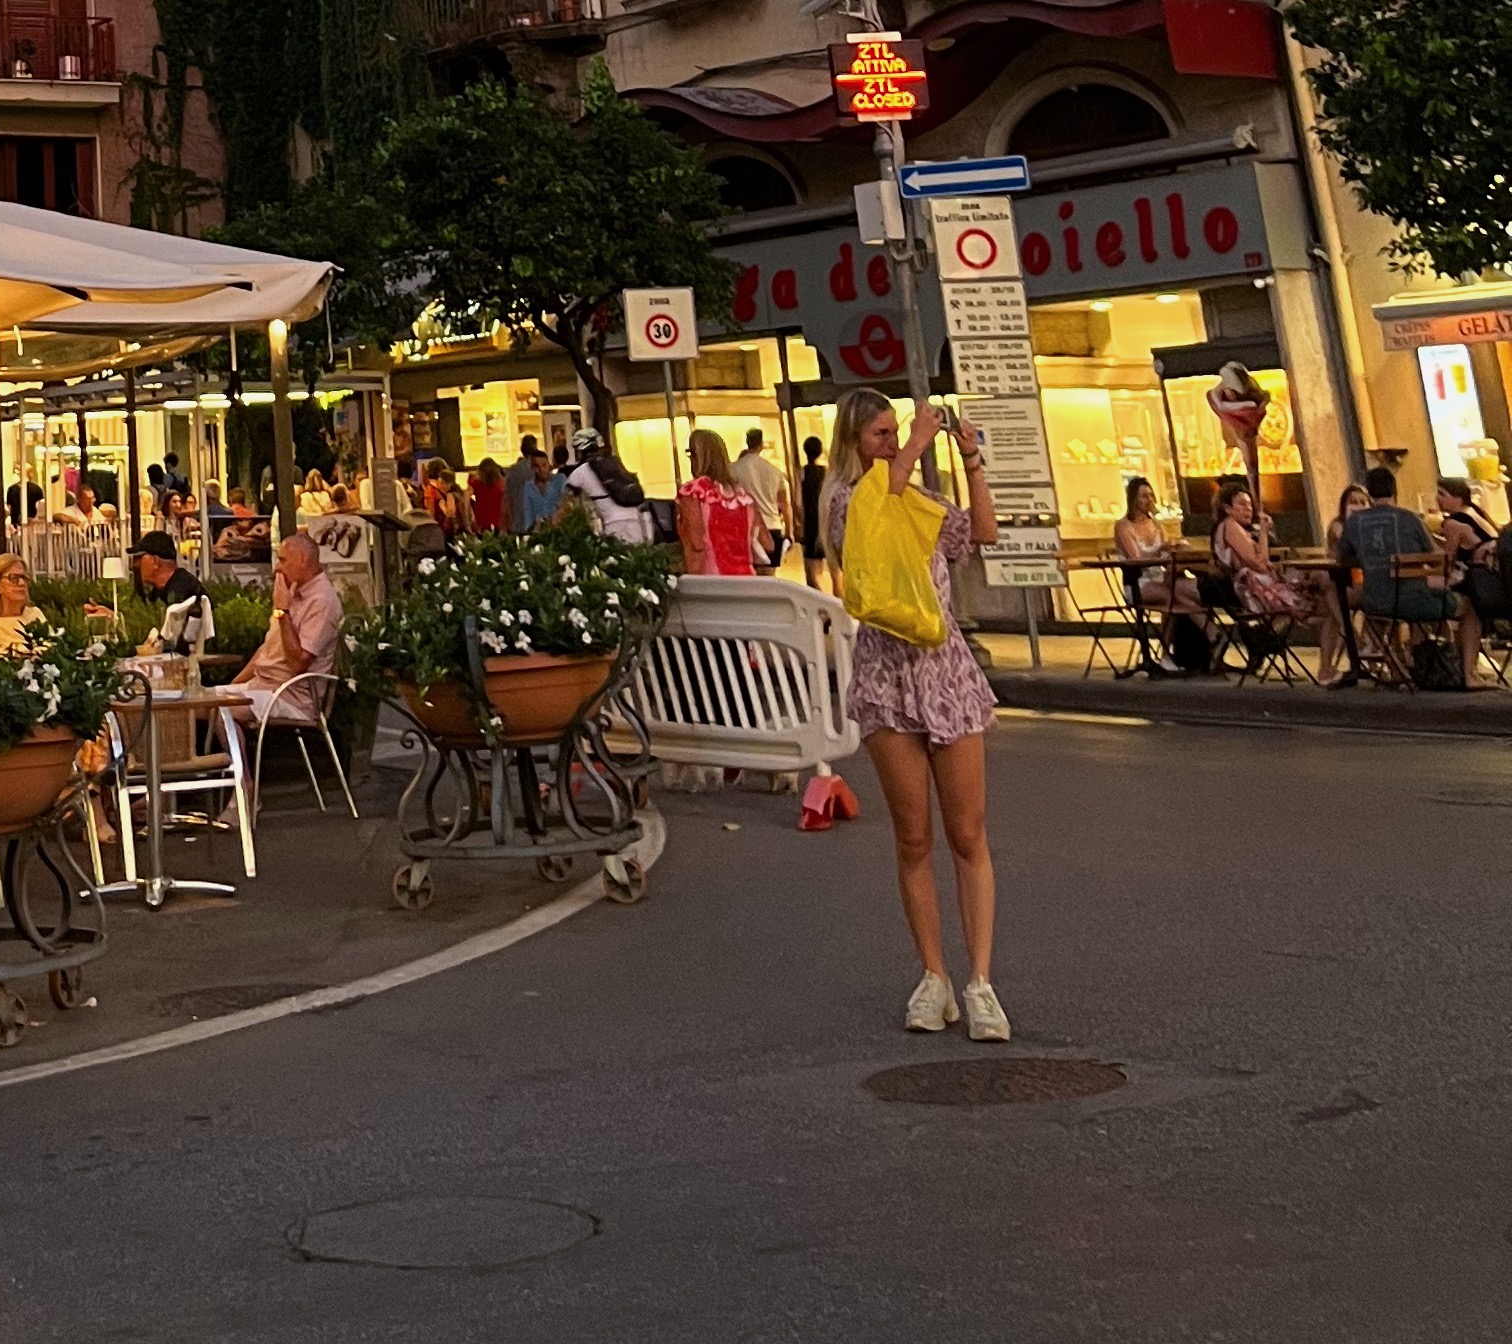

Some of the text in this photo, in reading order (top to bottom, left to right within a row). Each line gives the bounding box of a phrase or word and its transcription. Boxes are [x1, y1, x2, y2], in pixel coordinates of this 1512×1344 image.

[857, 43, 895, 59] ZTL
[852, 58, 907, 73] ATTIVA
[864, 78, 899, 94] ZTL
[852, 91, 916, 109] CLOSED
[731, 191, 1238, 324] ga de oiello
[653, 323, 672, 339] 30
[1025, 542, 1059, 552] ITALIA
